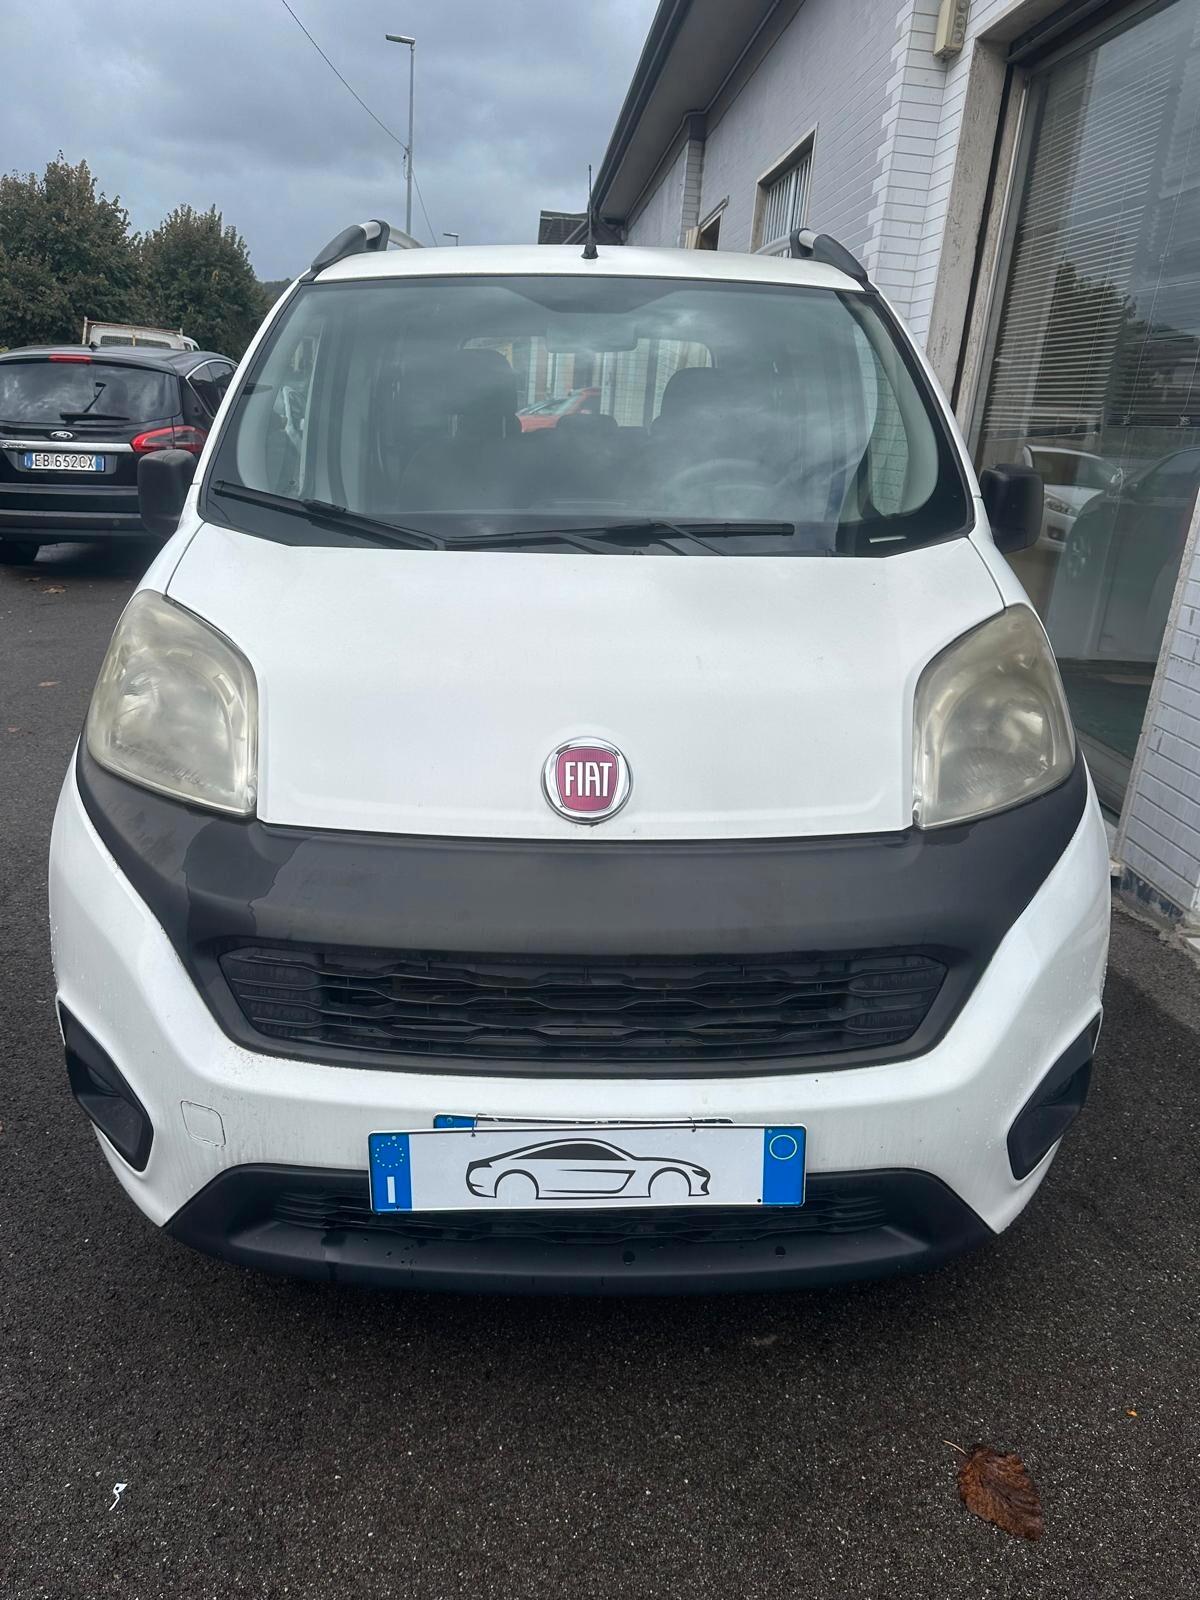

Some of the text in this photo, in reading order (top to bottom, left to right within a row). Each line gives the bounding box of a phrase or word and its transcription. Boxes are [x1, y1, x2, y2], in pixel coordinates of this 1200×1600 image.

[34, 454, 50, 467] EB
[54, 455, 95, 469] 652CX
[565, 761, 613, 797] FIAT
